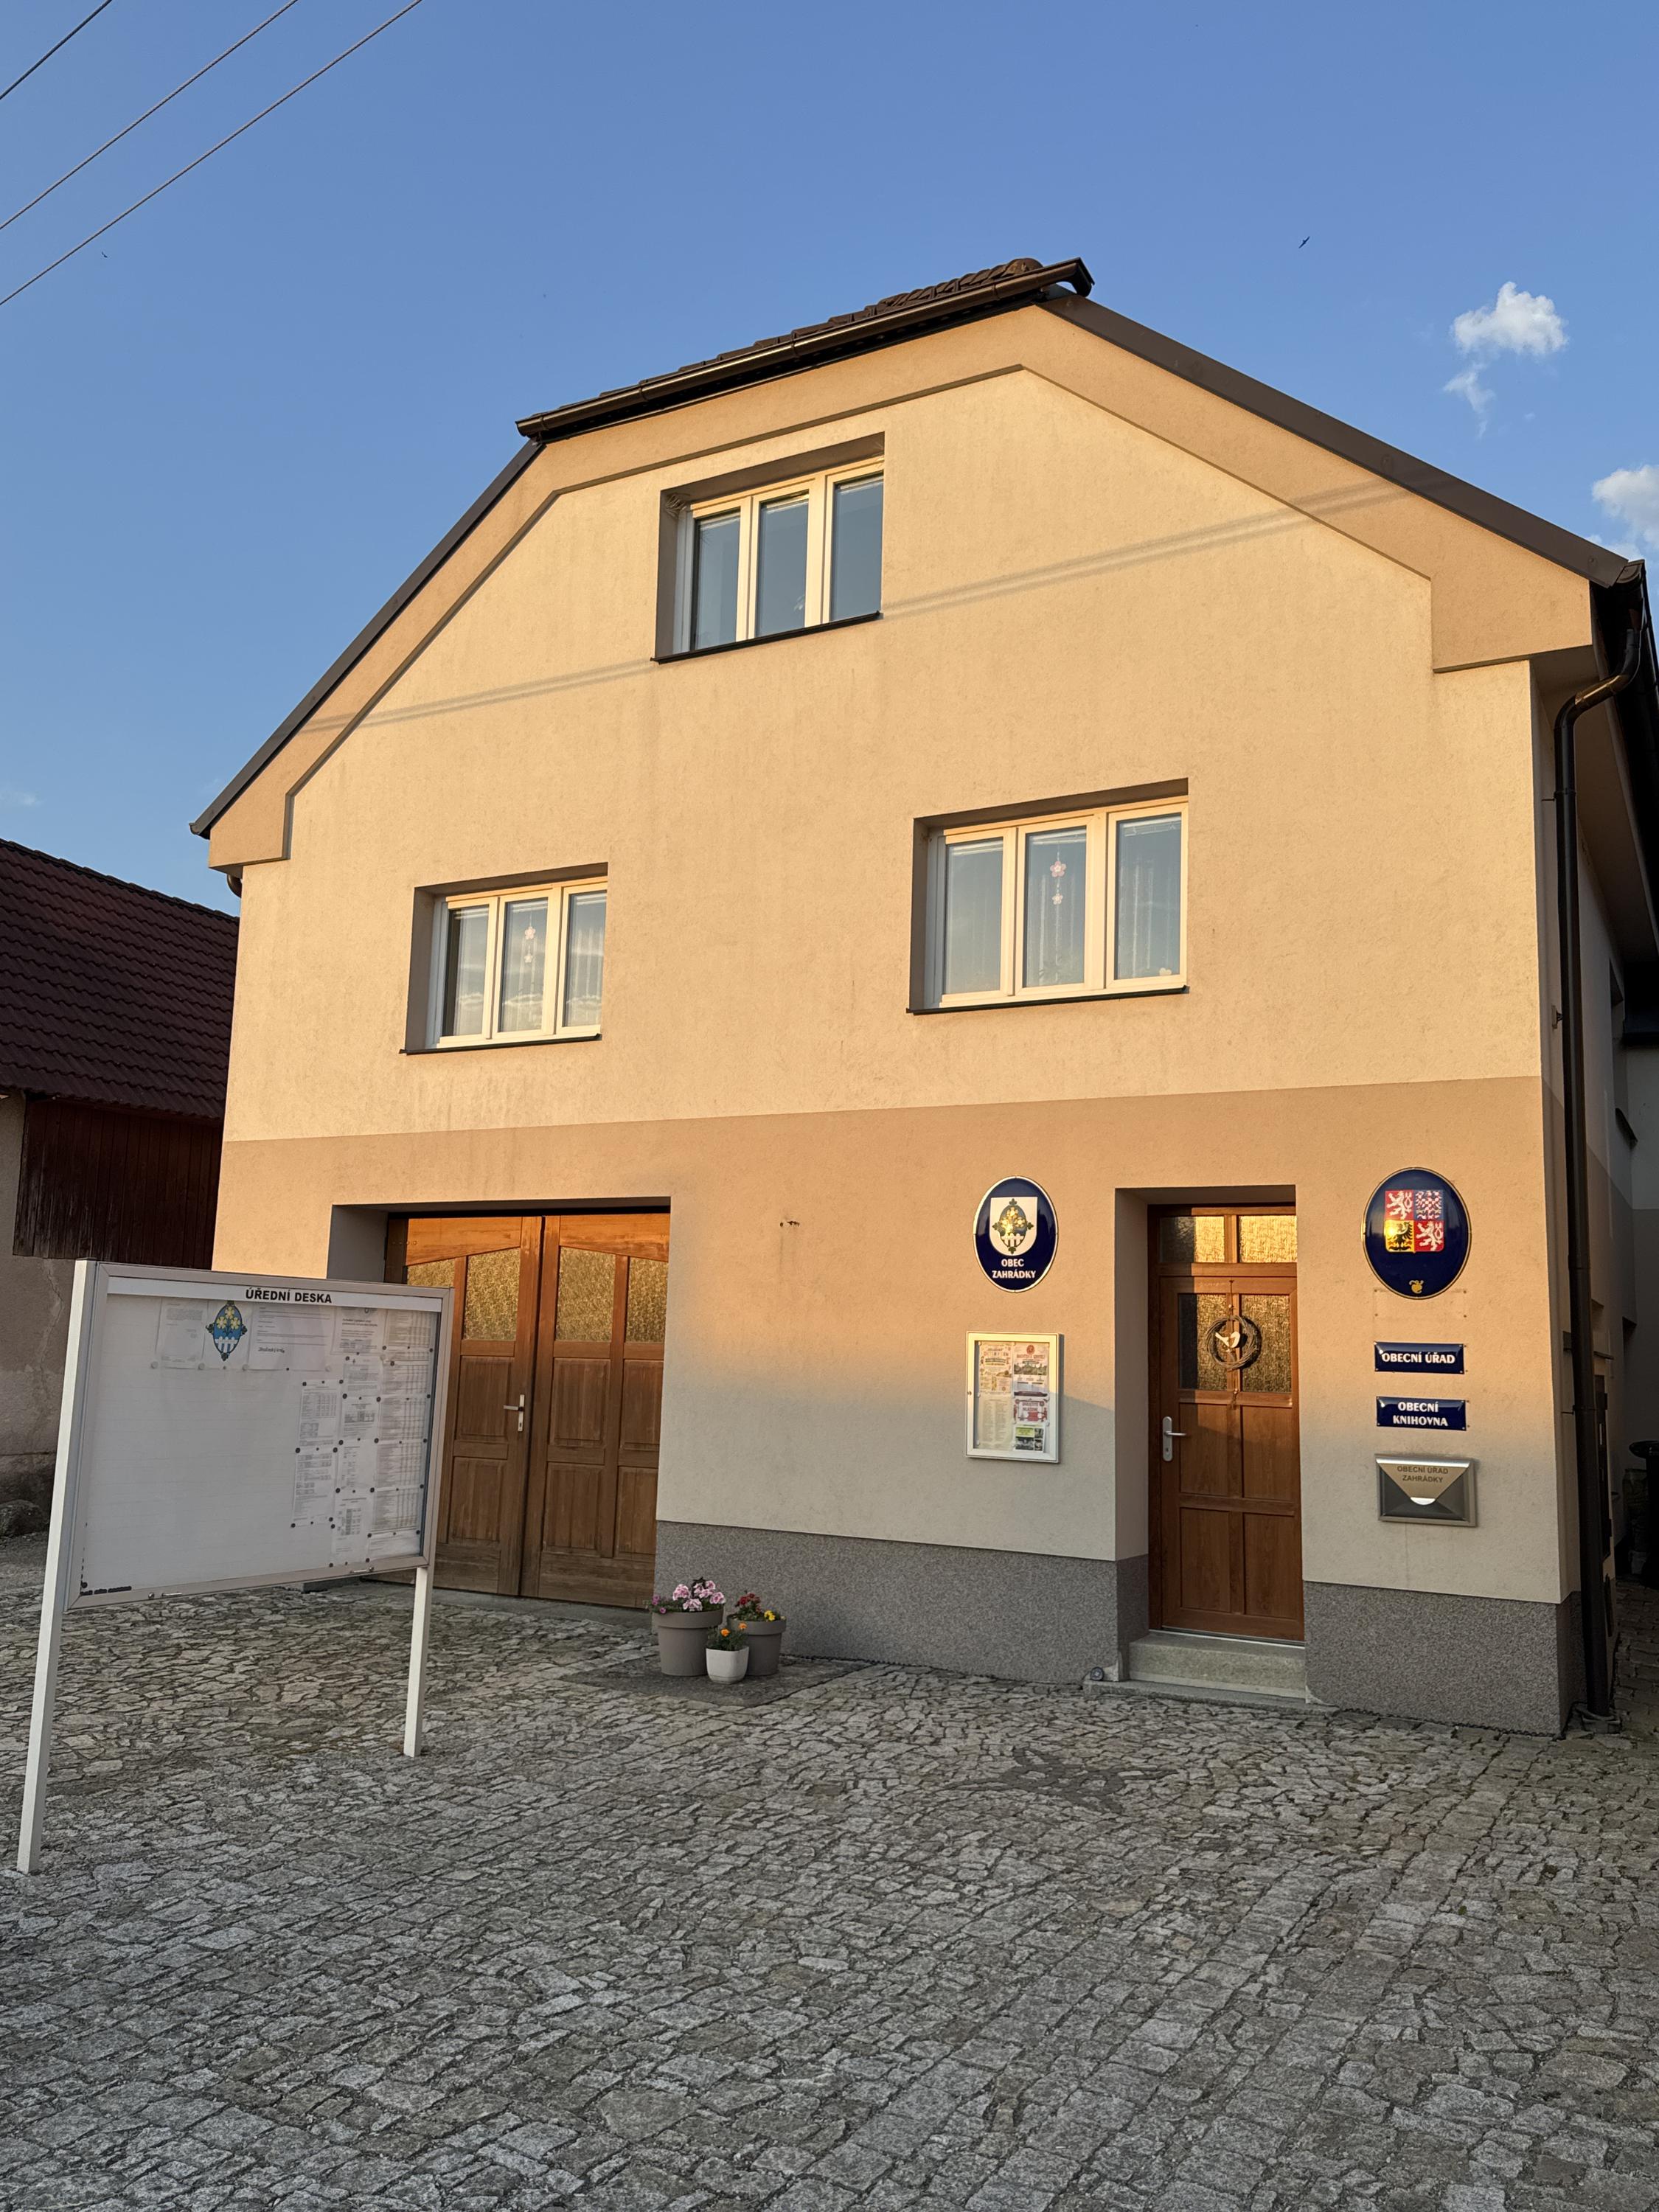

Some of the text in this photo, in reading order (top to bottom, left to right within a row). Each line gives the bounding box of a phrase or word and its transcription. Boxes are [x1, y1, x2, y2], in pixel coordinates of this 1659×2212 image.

[1001, 1258, 1024, 1267] OBEC
[991, 1268, 1036, 1279] ZAHRÁDKY
[246, 1287, 332, 1304] ÚŘEDNÍ DESKA
[1381, 1352, 1455, 1363] OBECNÍ ÚŘAD
[1397, 1401, 1439, 1413] OBECNÍ
[1392, 1414, 1449, 1427] KNIHOVNA
[1402, 1475, 1443, 1484] ZAHRÁDKY
